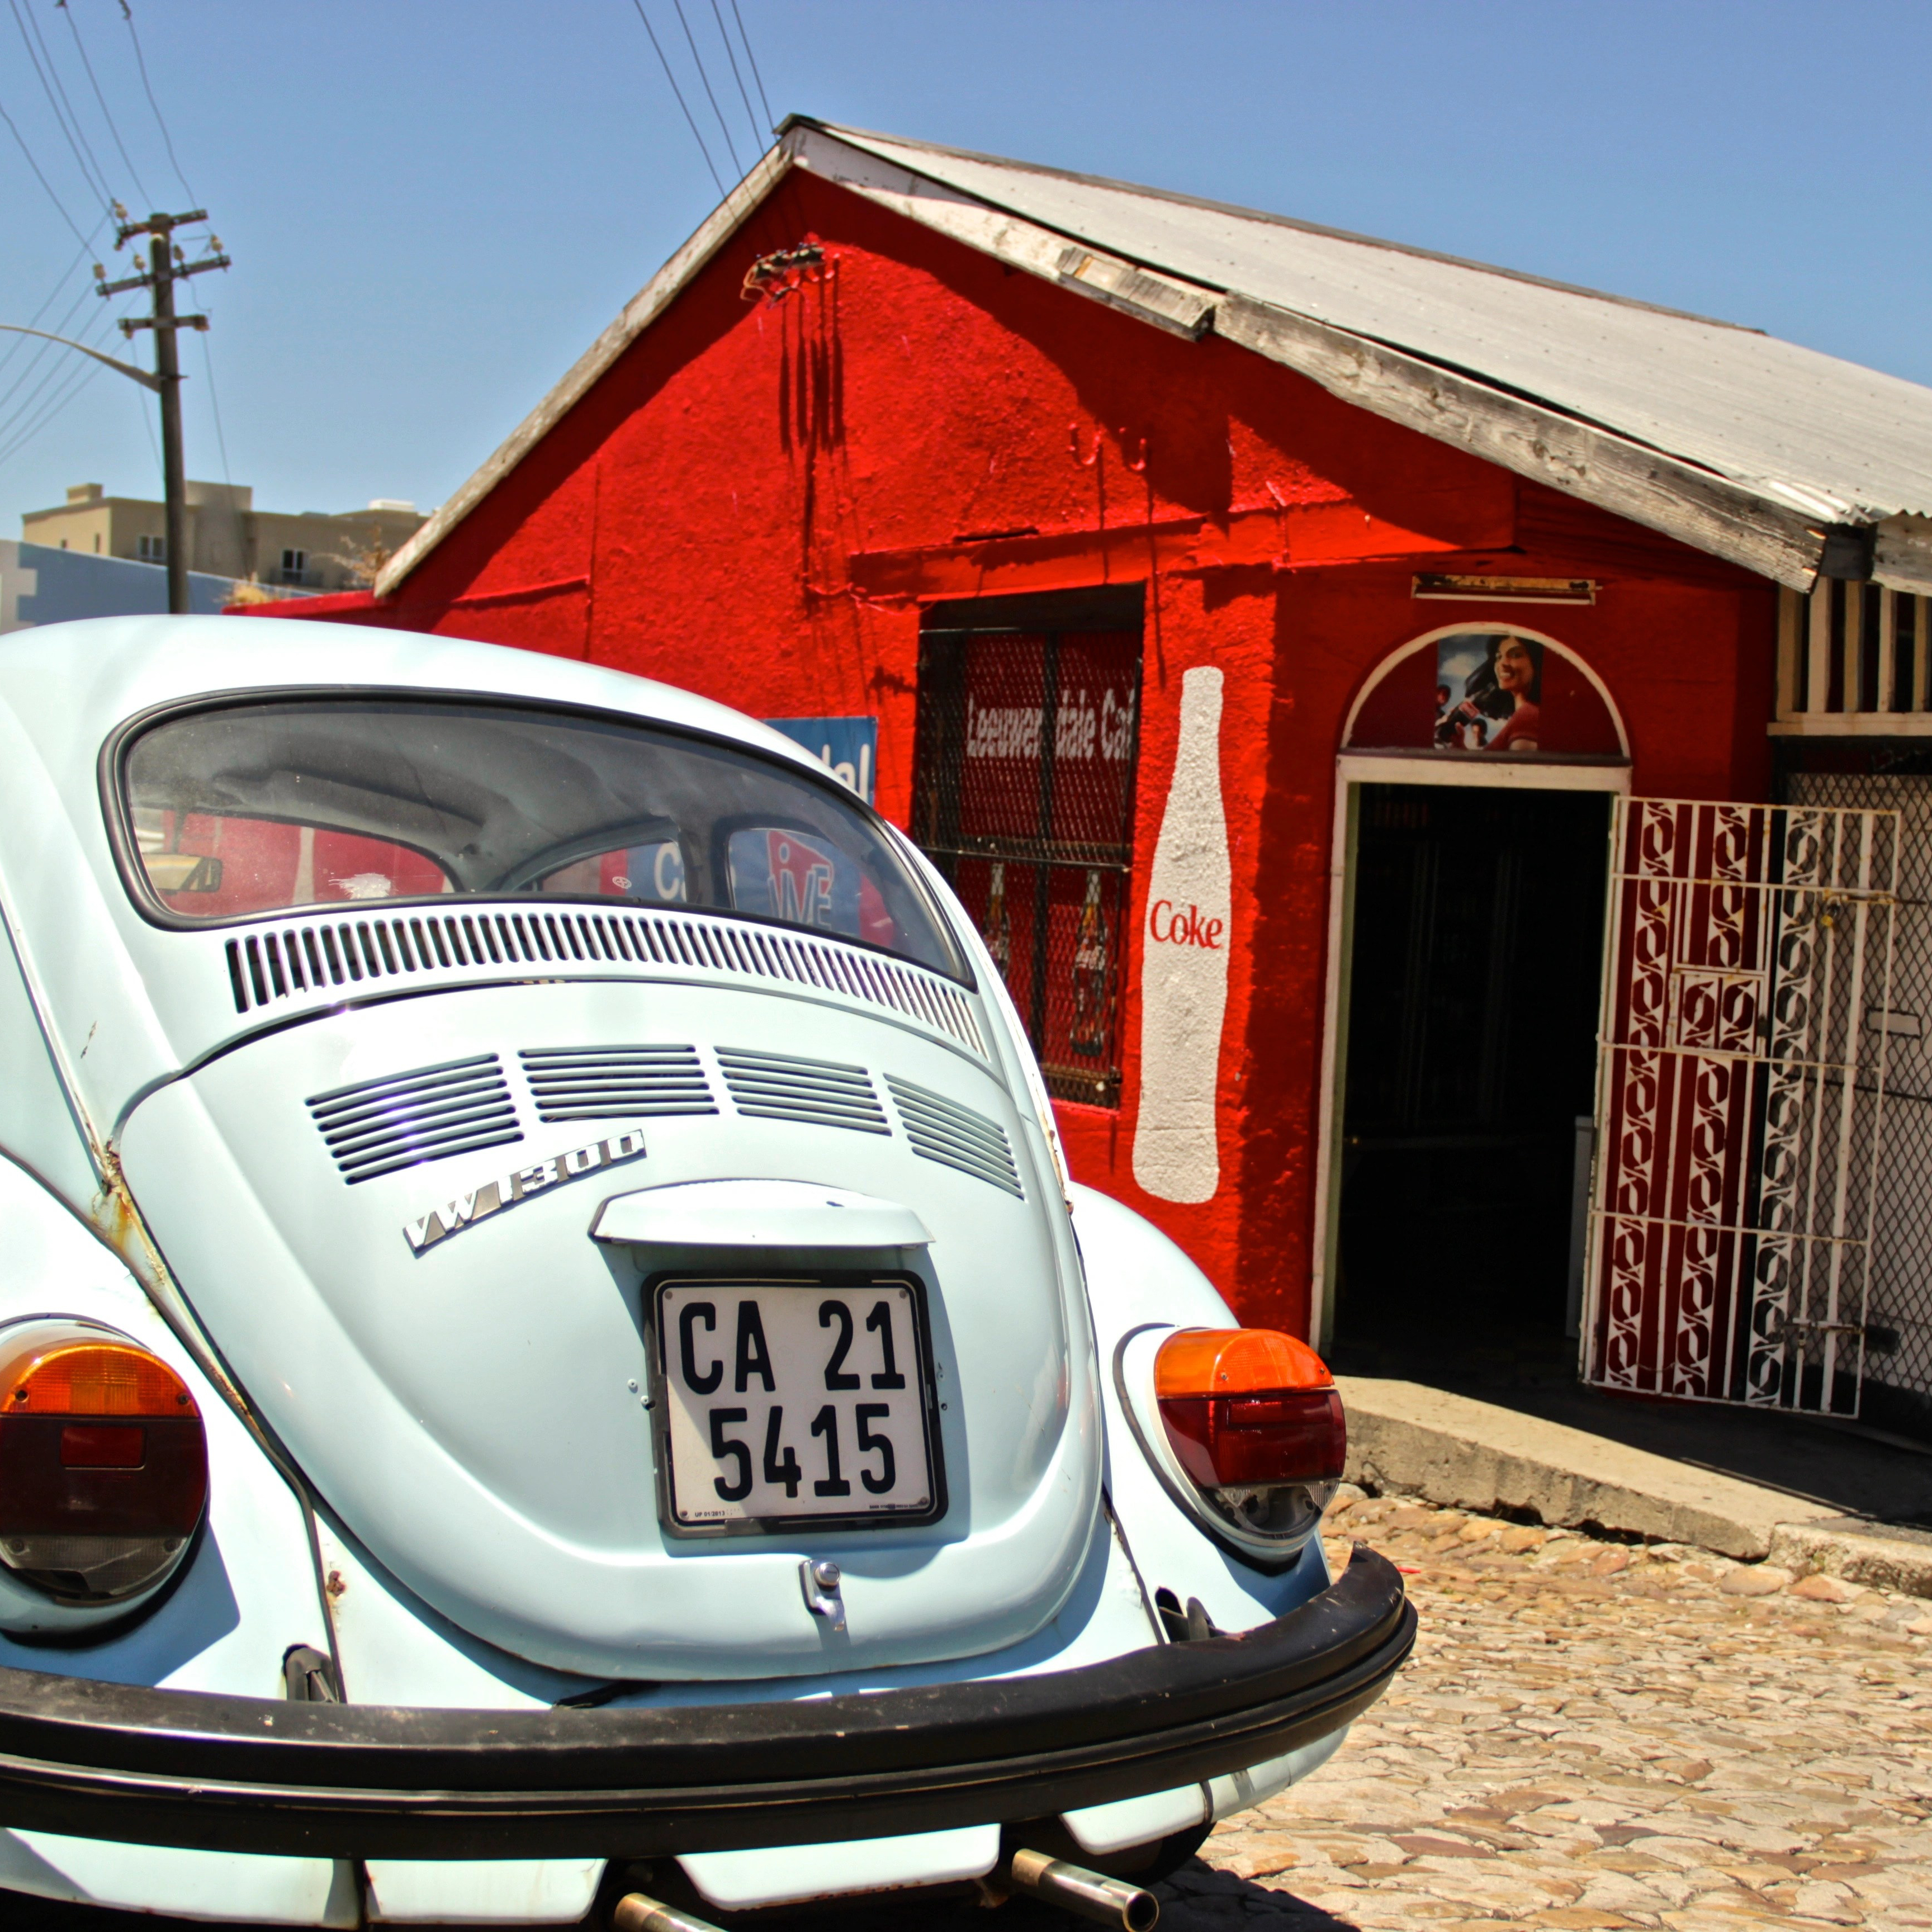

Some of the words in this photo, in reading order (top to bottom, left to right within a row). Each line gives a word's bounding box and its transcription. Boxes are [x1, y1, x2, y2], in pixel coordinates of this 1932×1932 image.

[1149, 899, 1223, 949] Coke
[403, 1189, 478, 1251] VW
[497, 1129, 646, 1204] 1300
[679, 1300, 776, 1395] CA
[818, 1300, 906, 1391] 21
[709, 1403, 896, 1502] 5415
